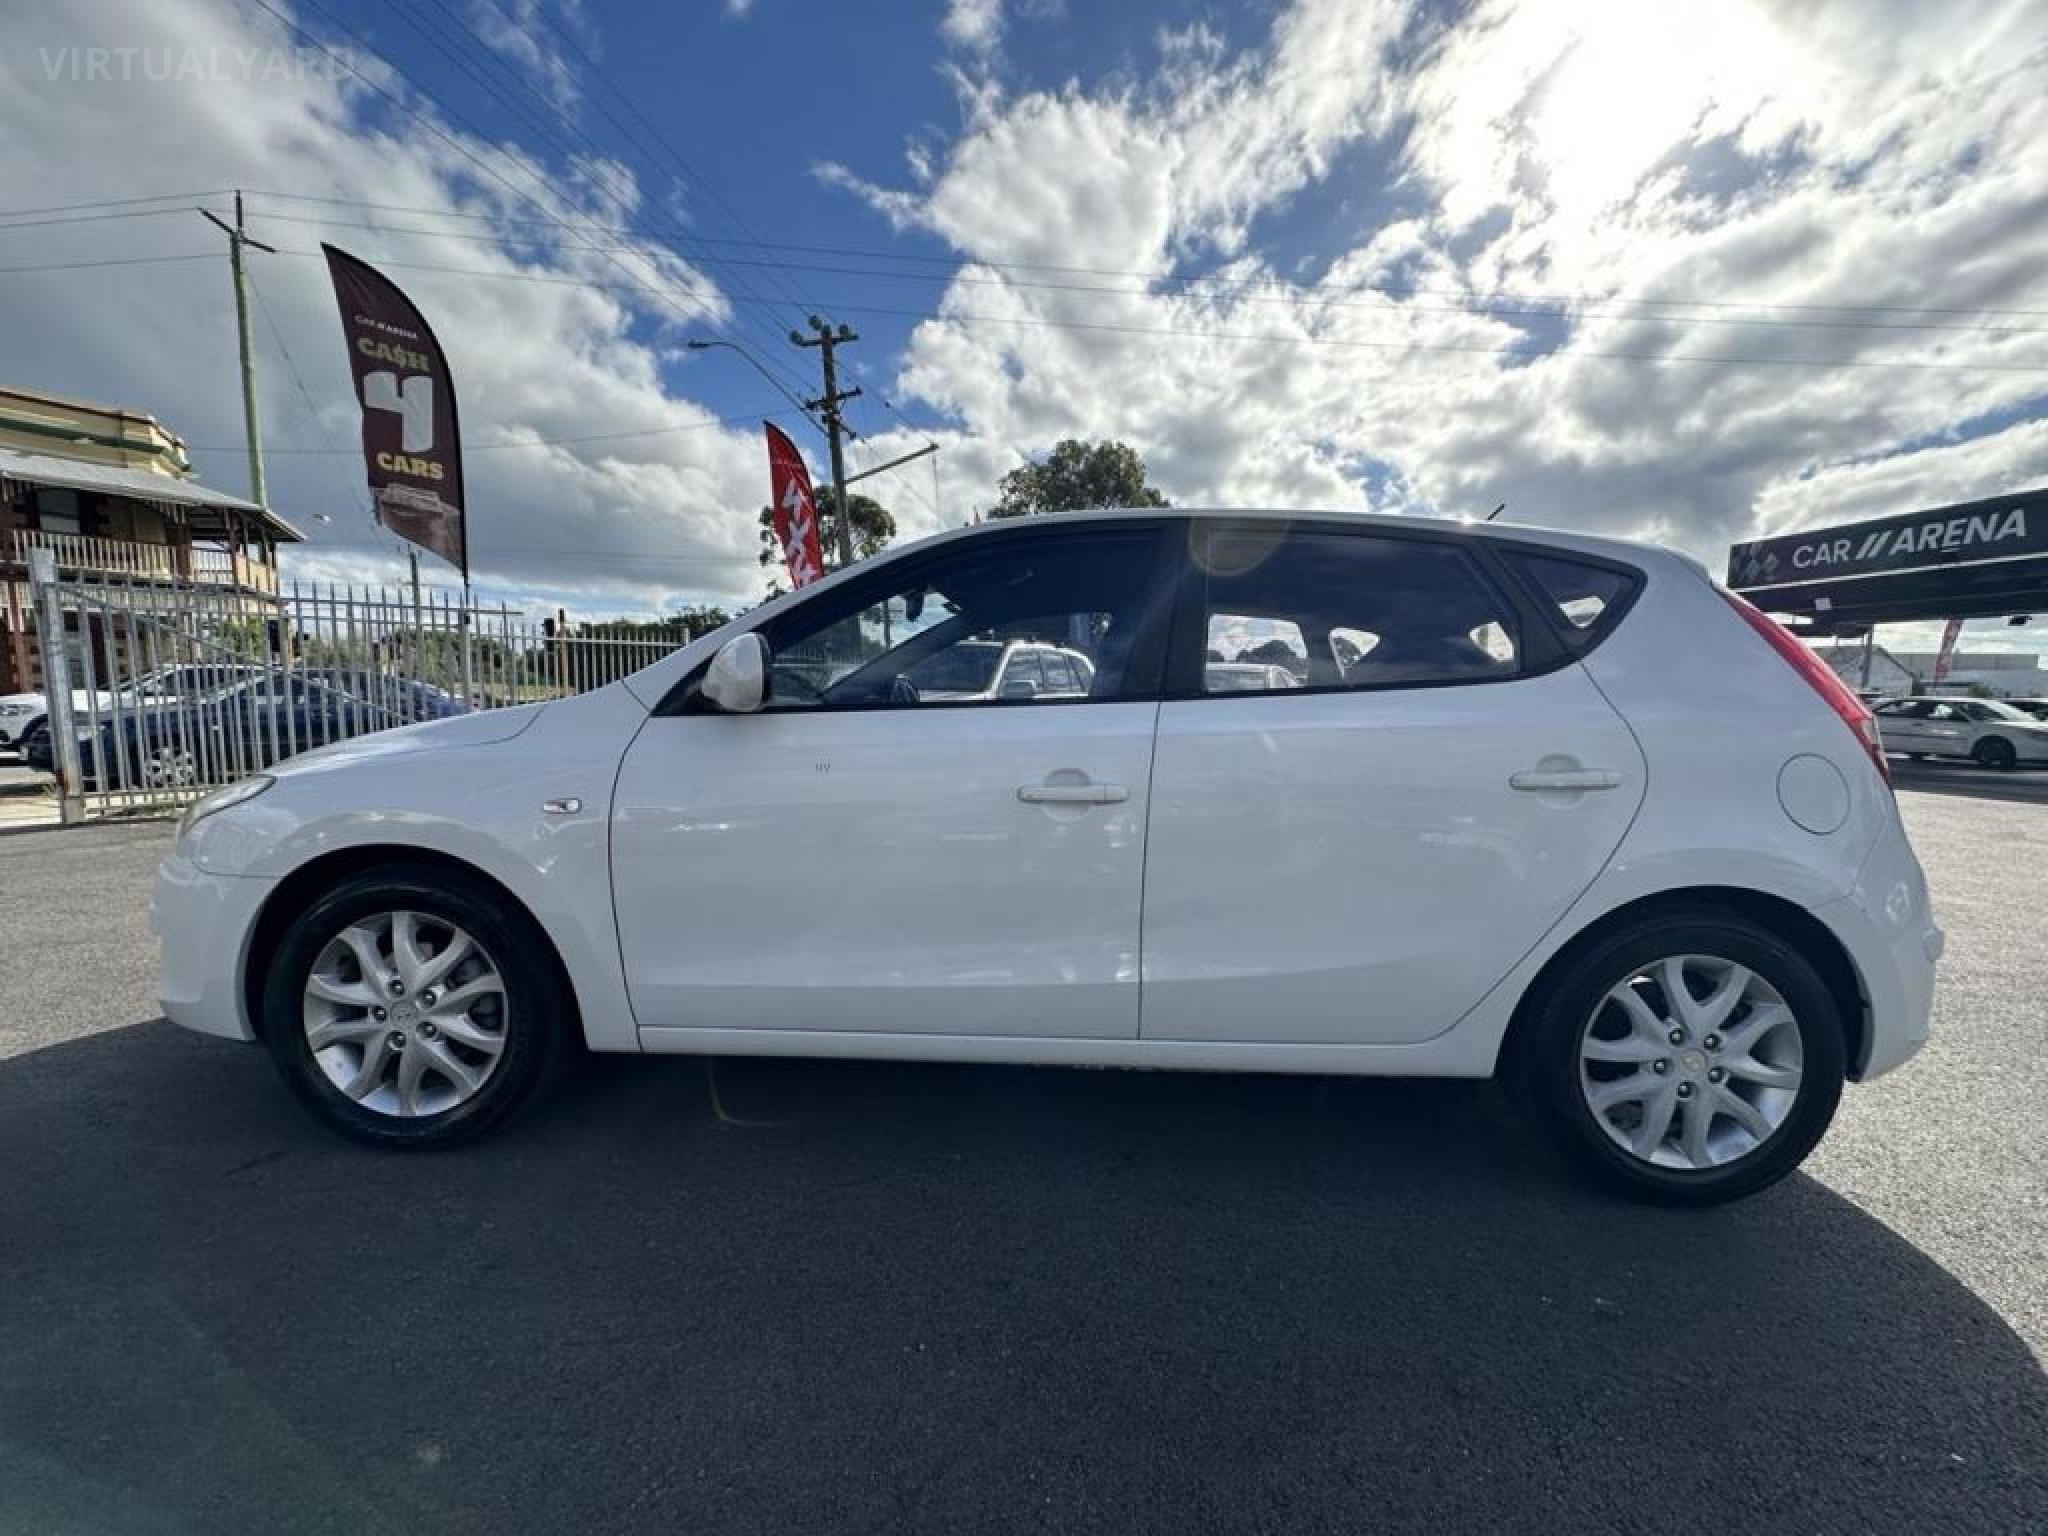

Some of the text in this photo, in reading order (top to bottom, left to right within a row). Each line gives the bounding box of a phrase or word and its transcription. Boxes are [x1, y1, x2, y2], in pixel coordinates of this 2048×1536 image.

[364, 372, 433, 452] 4
[376, 452, 443, 479] CARS
[1792, 538, 1850, 569] CAR
[1890, 508, 2026, 554] ARENA
